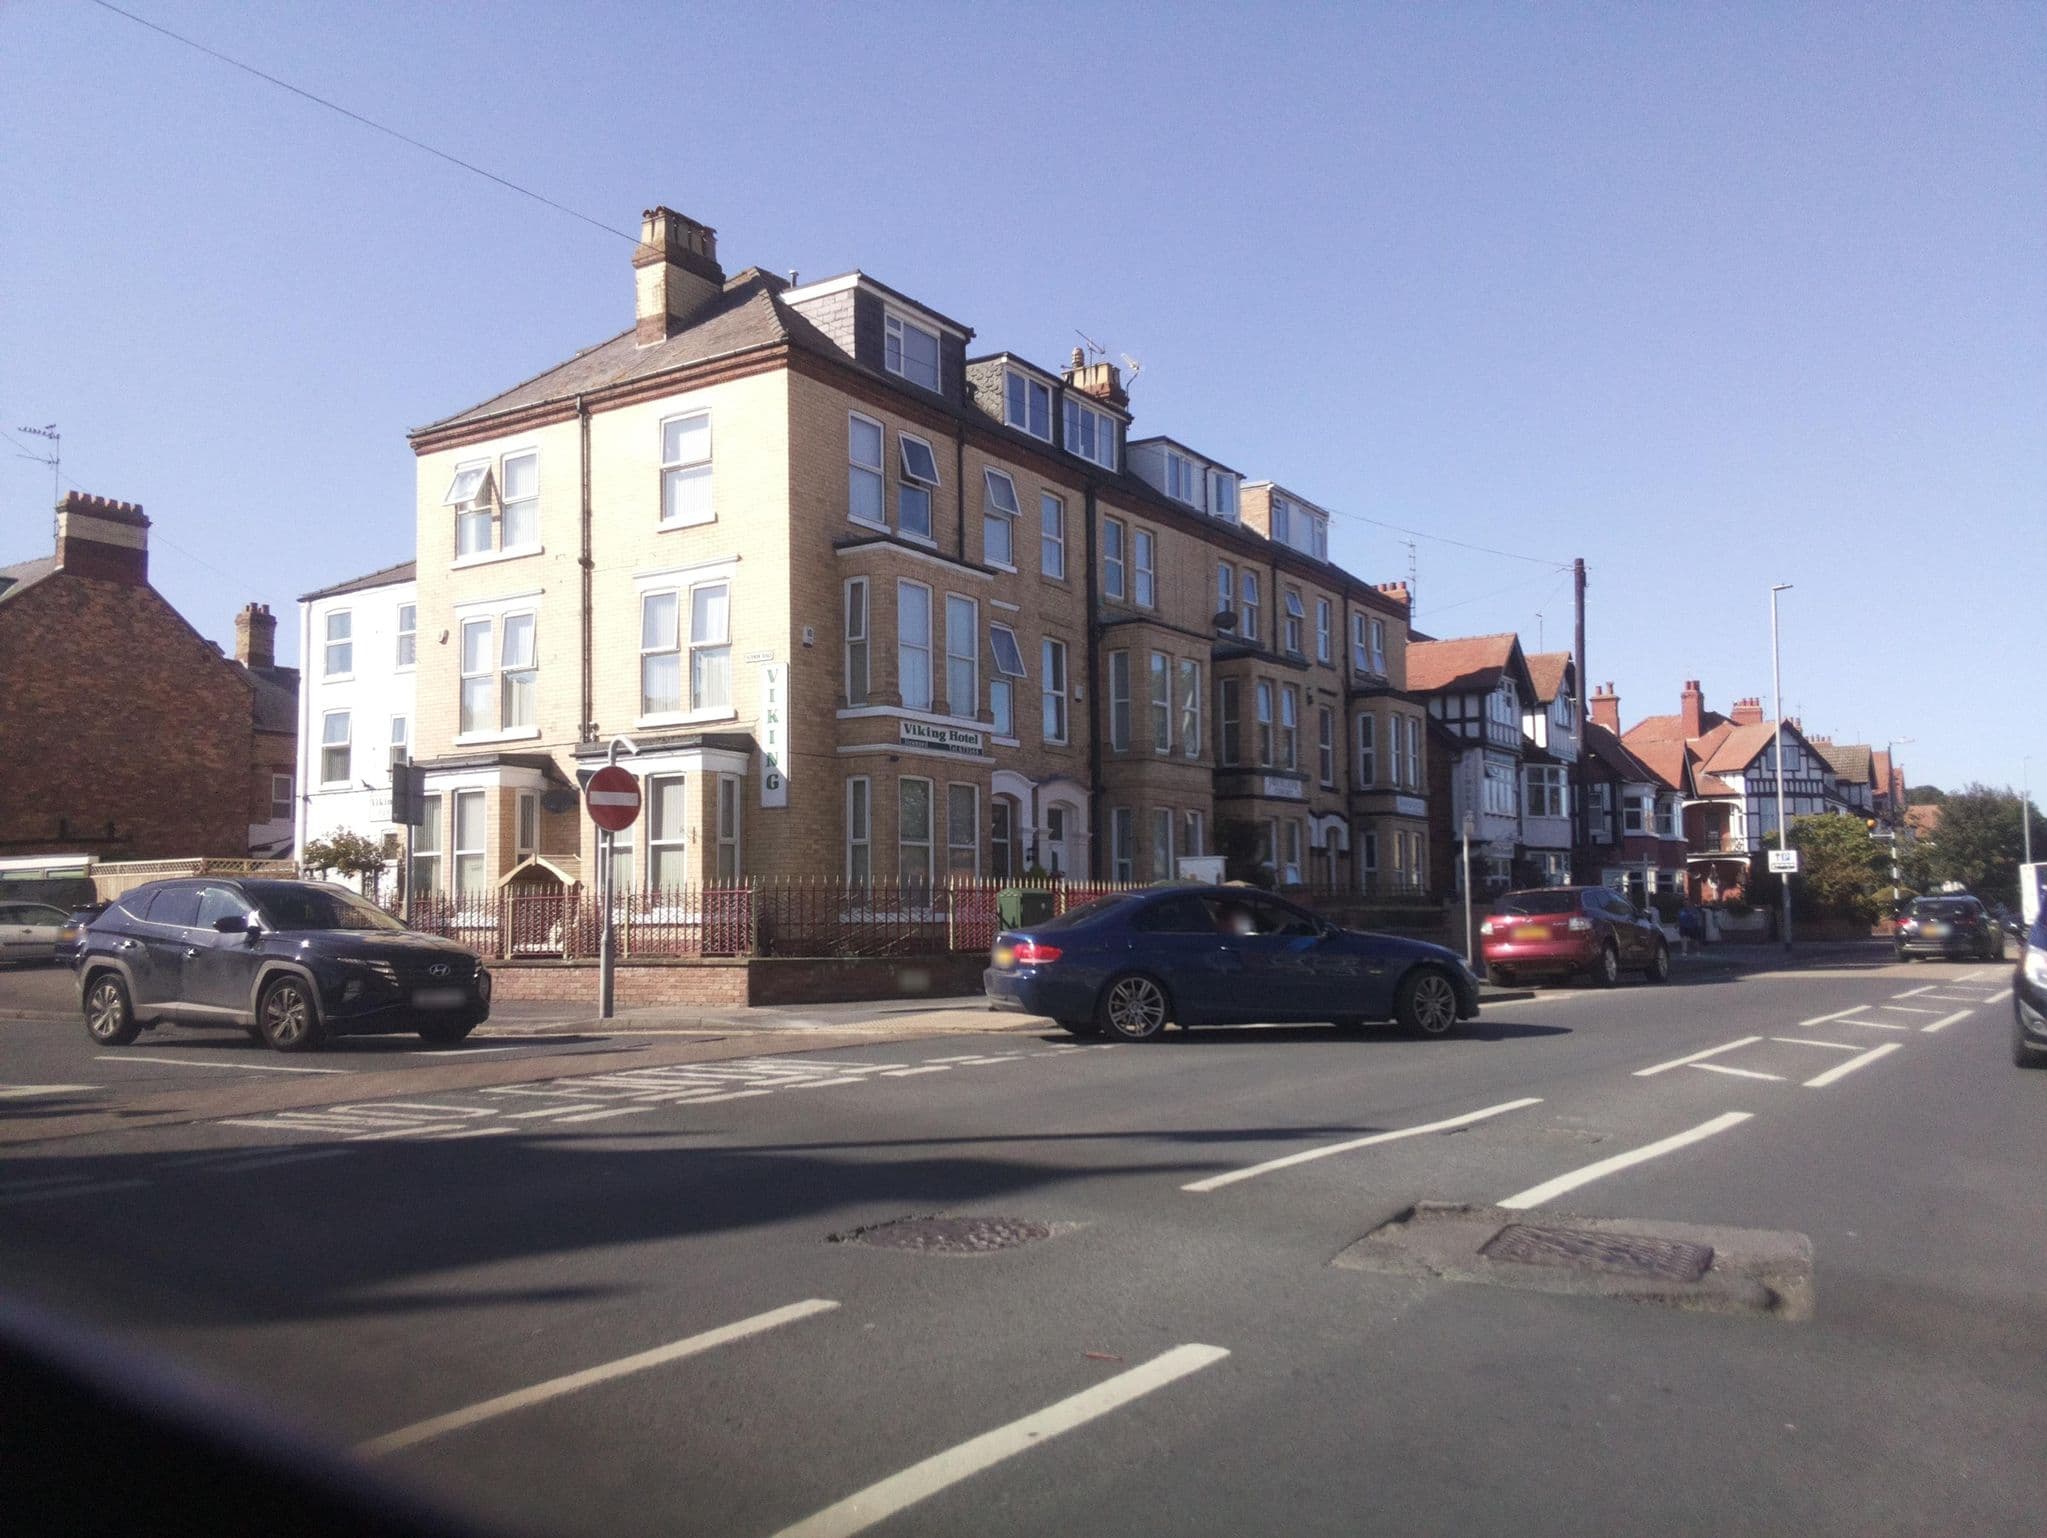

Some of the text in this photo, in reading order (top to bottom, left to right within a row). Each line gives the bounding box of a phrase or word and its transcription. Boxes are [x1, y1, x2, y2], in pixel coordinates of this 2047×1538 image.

[766, 669, 779, 790] VIKING
[904, 723, 979, 745] Viking Hotel
